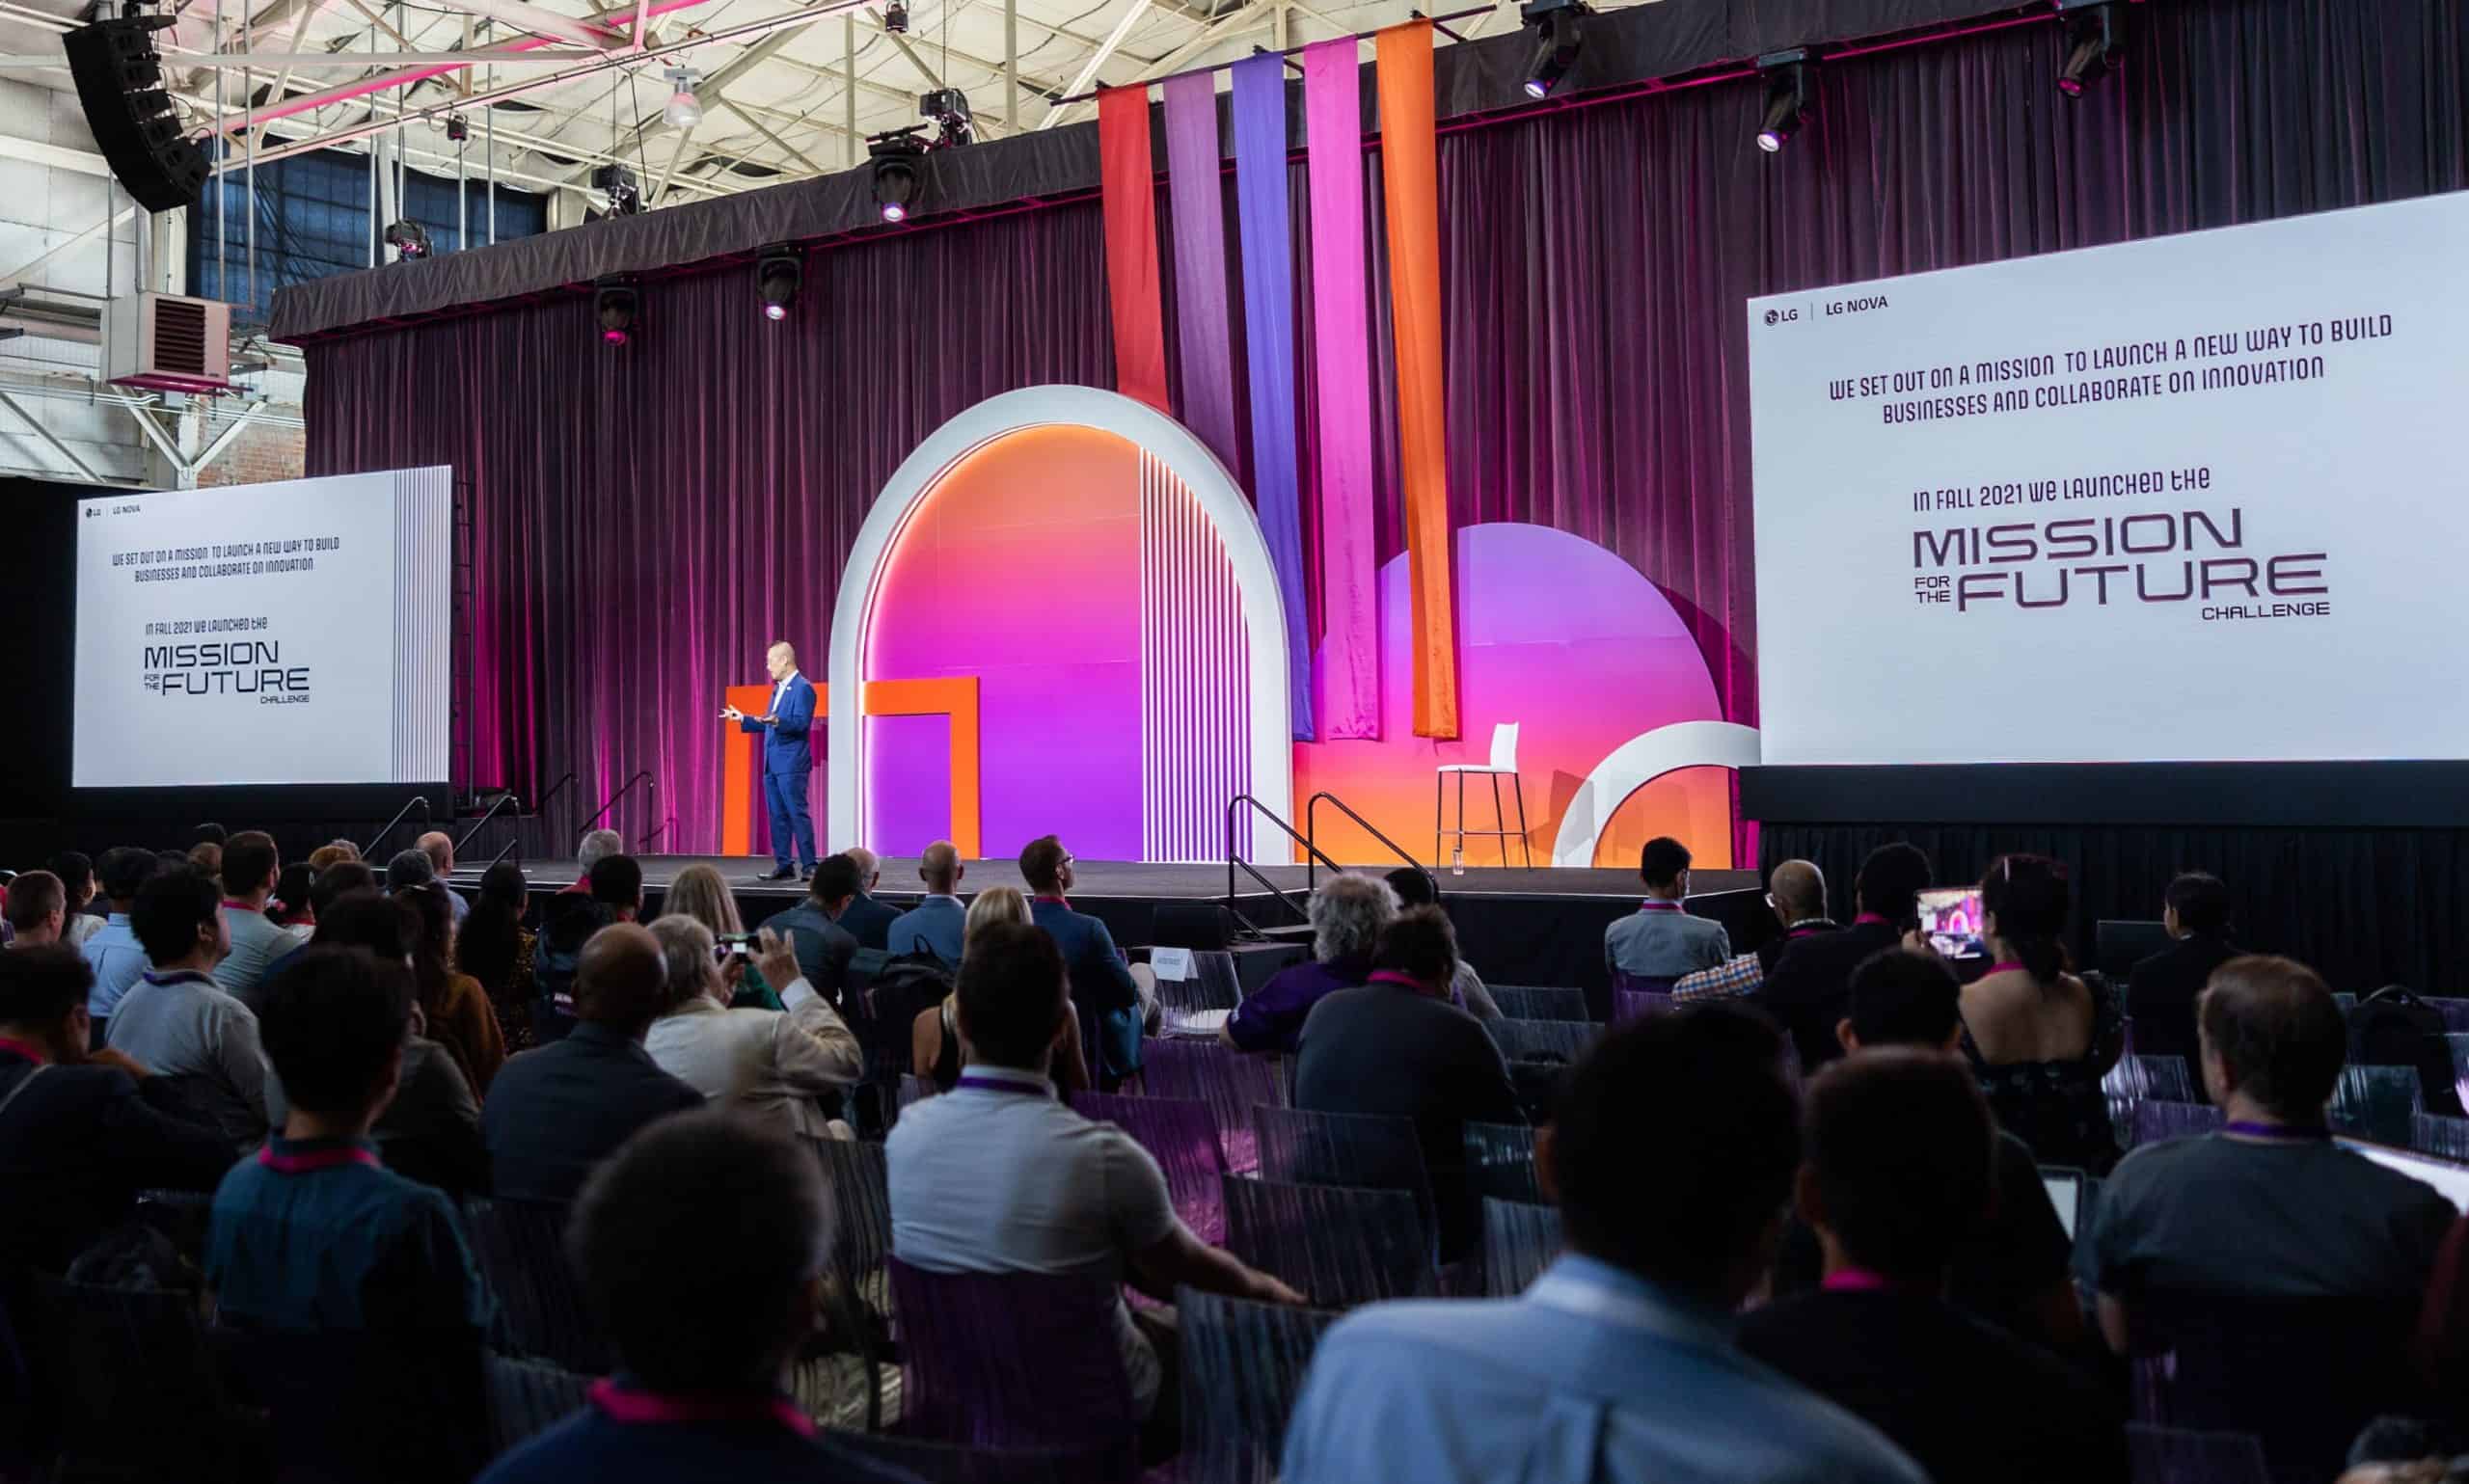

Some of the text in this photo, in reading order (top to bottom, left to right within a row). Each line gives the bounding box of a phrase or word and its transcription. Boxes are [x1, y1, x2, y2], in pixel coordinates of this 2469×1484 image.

[1780, 308, 1799, 322] LG
[1826, 295, 1888, 316] LG NOVA
[1829, 313, 2392, 401] WE SET OUT ON A MISSION TO LAUNCH A NEW WAY TO BUILD
[1883, 355, 2324, 424] BUSINESSES AND COLLABORATE ON INNOVATION
[1913, 491, 1930, 512] IN
[1936, 487, 1975, 510] FALL
[1979, 483, 2022, 507] 2021
[112, 536, 340, 567] WE SET OUT ON A MISSION TO LAUNCH A NEW WAY TO BUILD
[1913, 507, 2242, 569] MISSION
[134, 556, 314, 583] BUSINESSES AND COLLABORATE ON INNOVATION
[1914, 575, 1951, 589] FOR
[1957, 553, 2329, 612] FUTURE
[1914, 589, 1951, 604] THE
[2201, 601, 2331, 621] CHALLENGE
[145, 622, 154, 636] IN
[154, 621, 173, 635] FALL
[173, 620, 193, 635] 2021
[144, 639, 279, 670] MISSION
[162, 666, 311, 696] FUTURE
[259, 693, 310, 705] CHALLENGE
